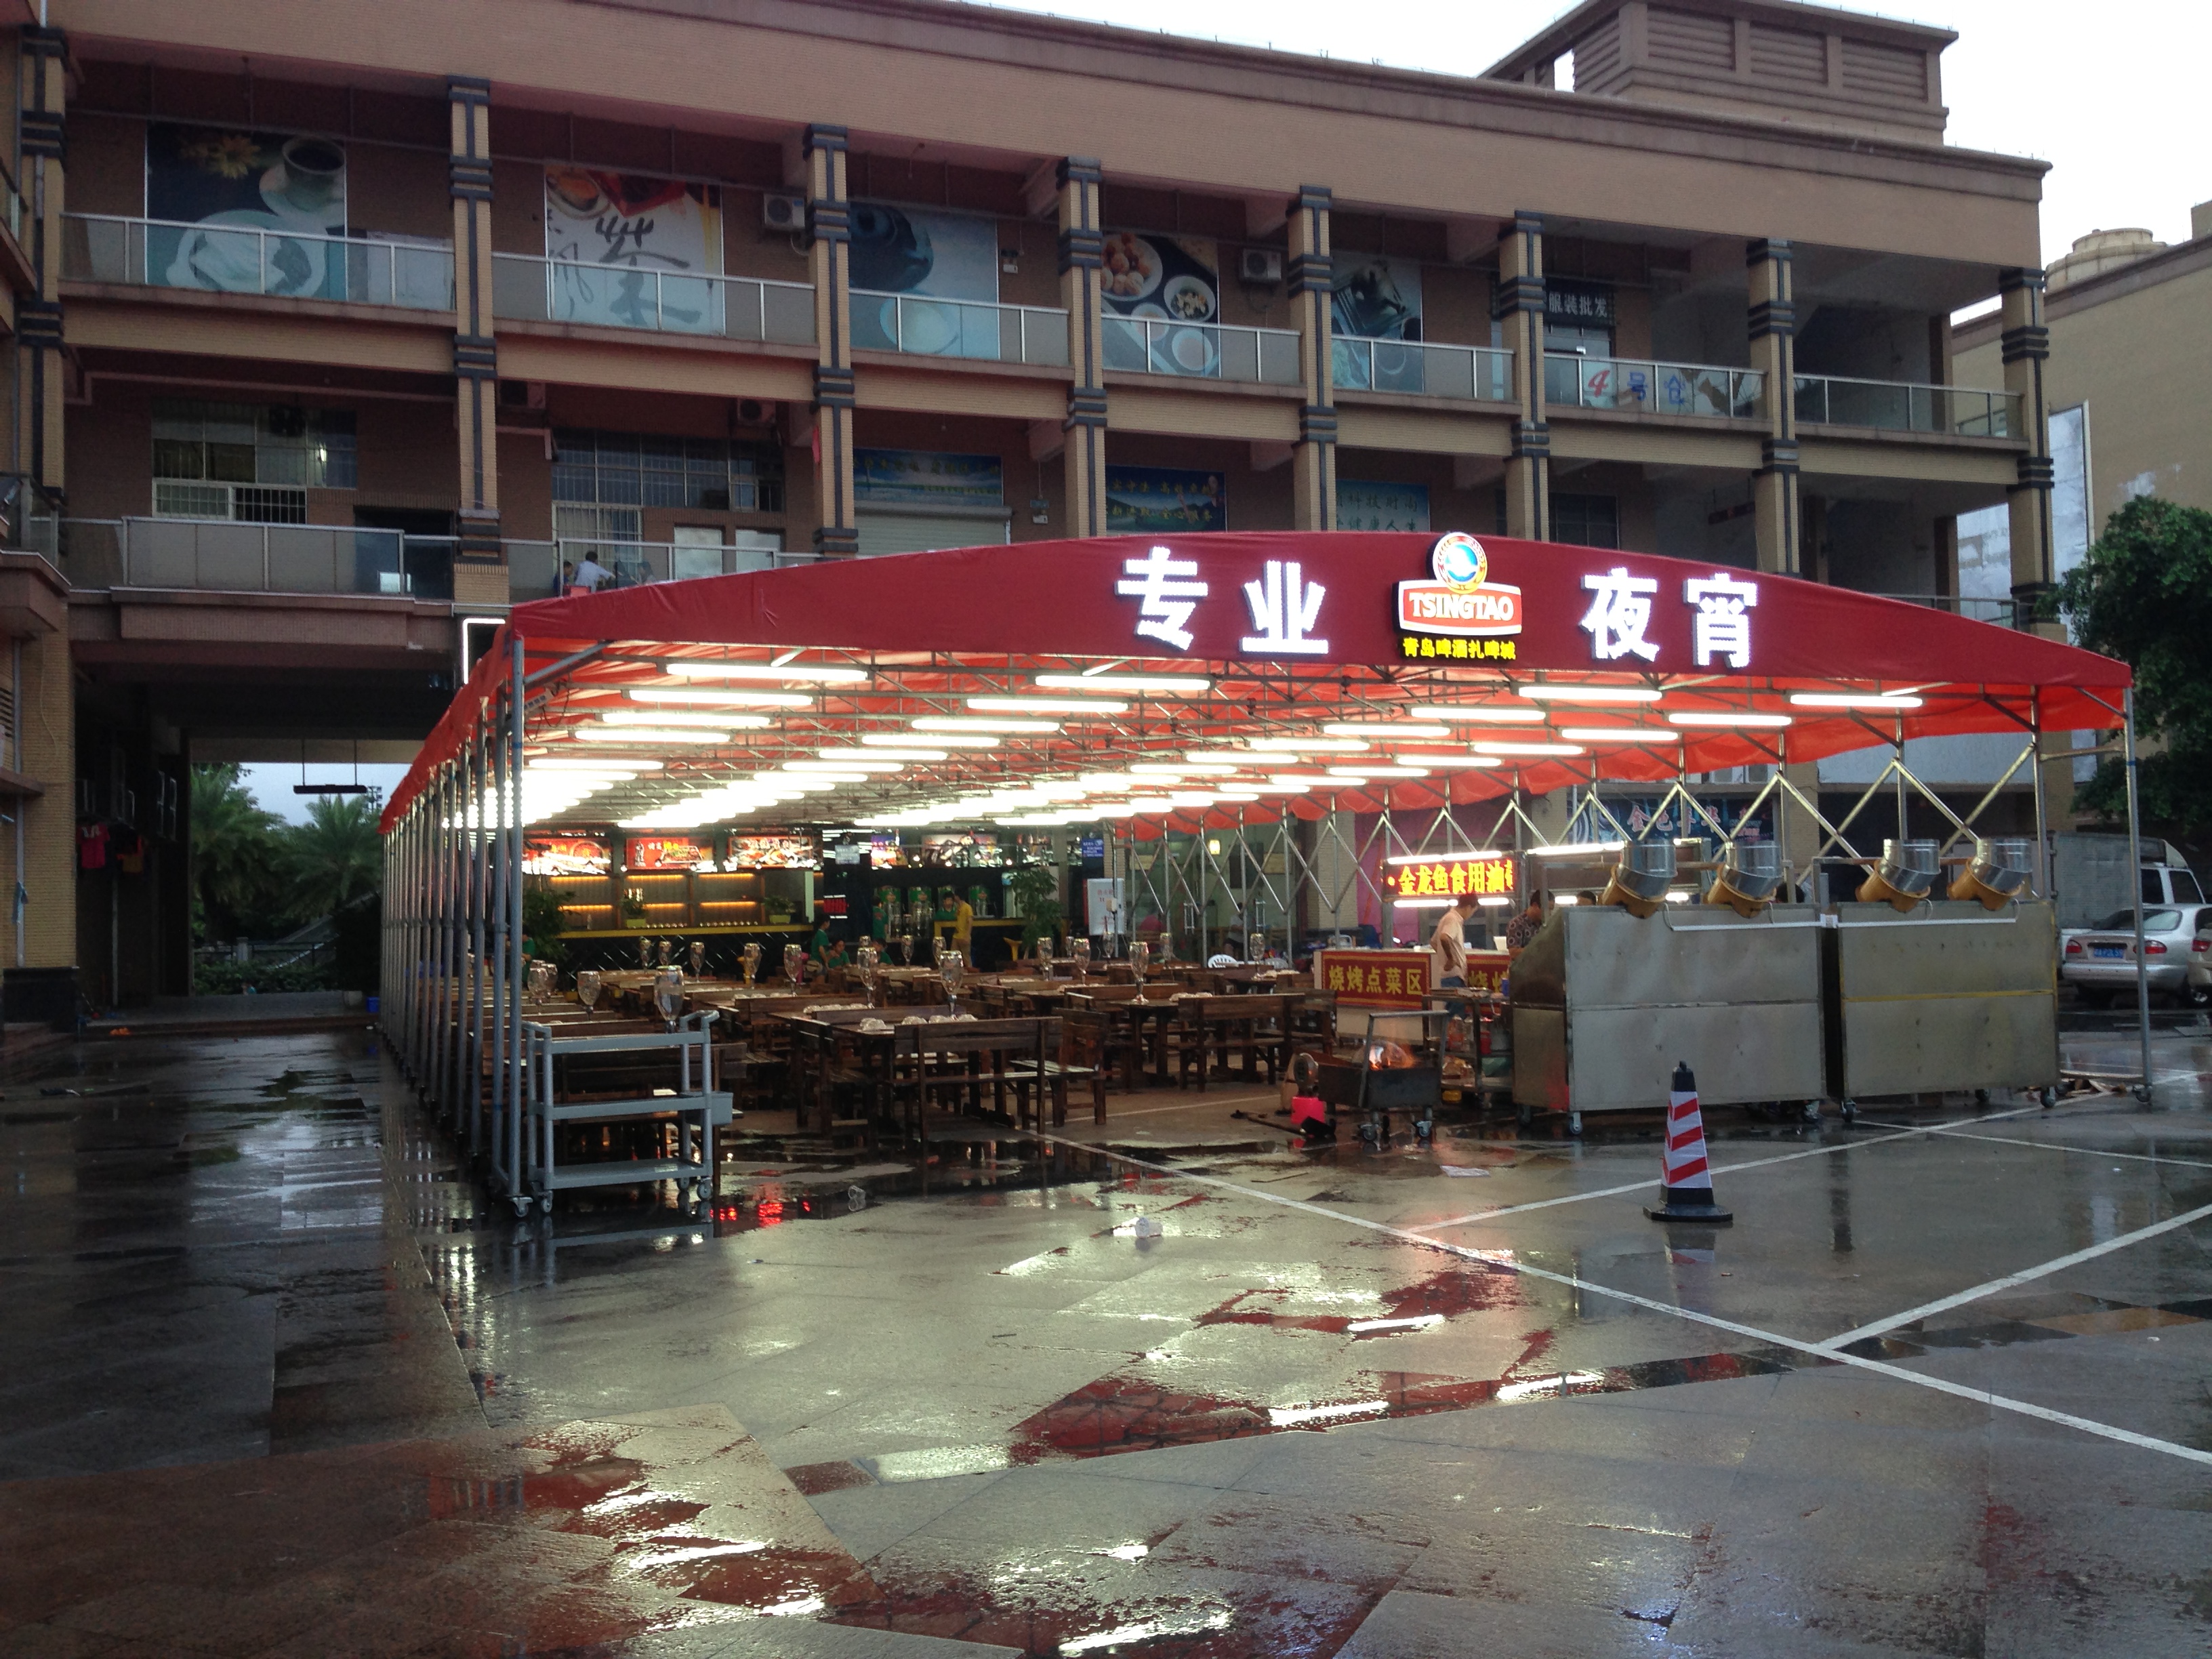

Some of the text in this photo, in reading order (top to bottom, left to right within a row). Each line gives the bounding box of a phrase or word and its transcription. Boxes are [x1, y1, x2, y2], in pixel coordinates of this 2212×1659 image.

[1549, 291, 1608, 318] 服装批发
[1588, 369, 1686, 406] 4号仓
[1115, 546, 1761, 669] 专业 夜宵
[1408, 592, 1514, 621] TSINGTAO
[1402, 636, 1517, 660] 青岛啤酒扎啤城
[1328, 964, 1423, 996] 烧烤点菜区
